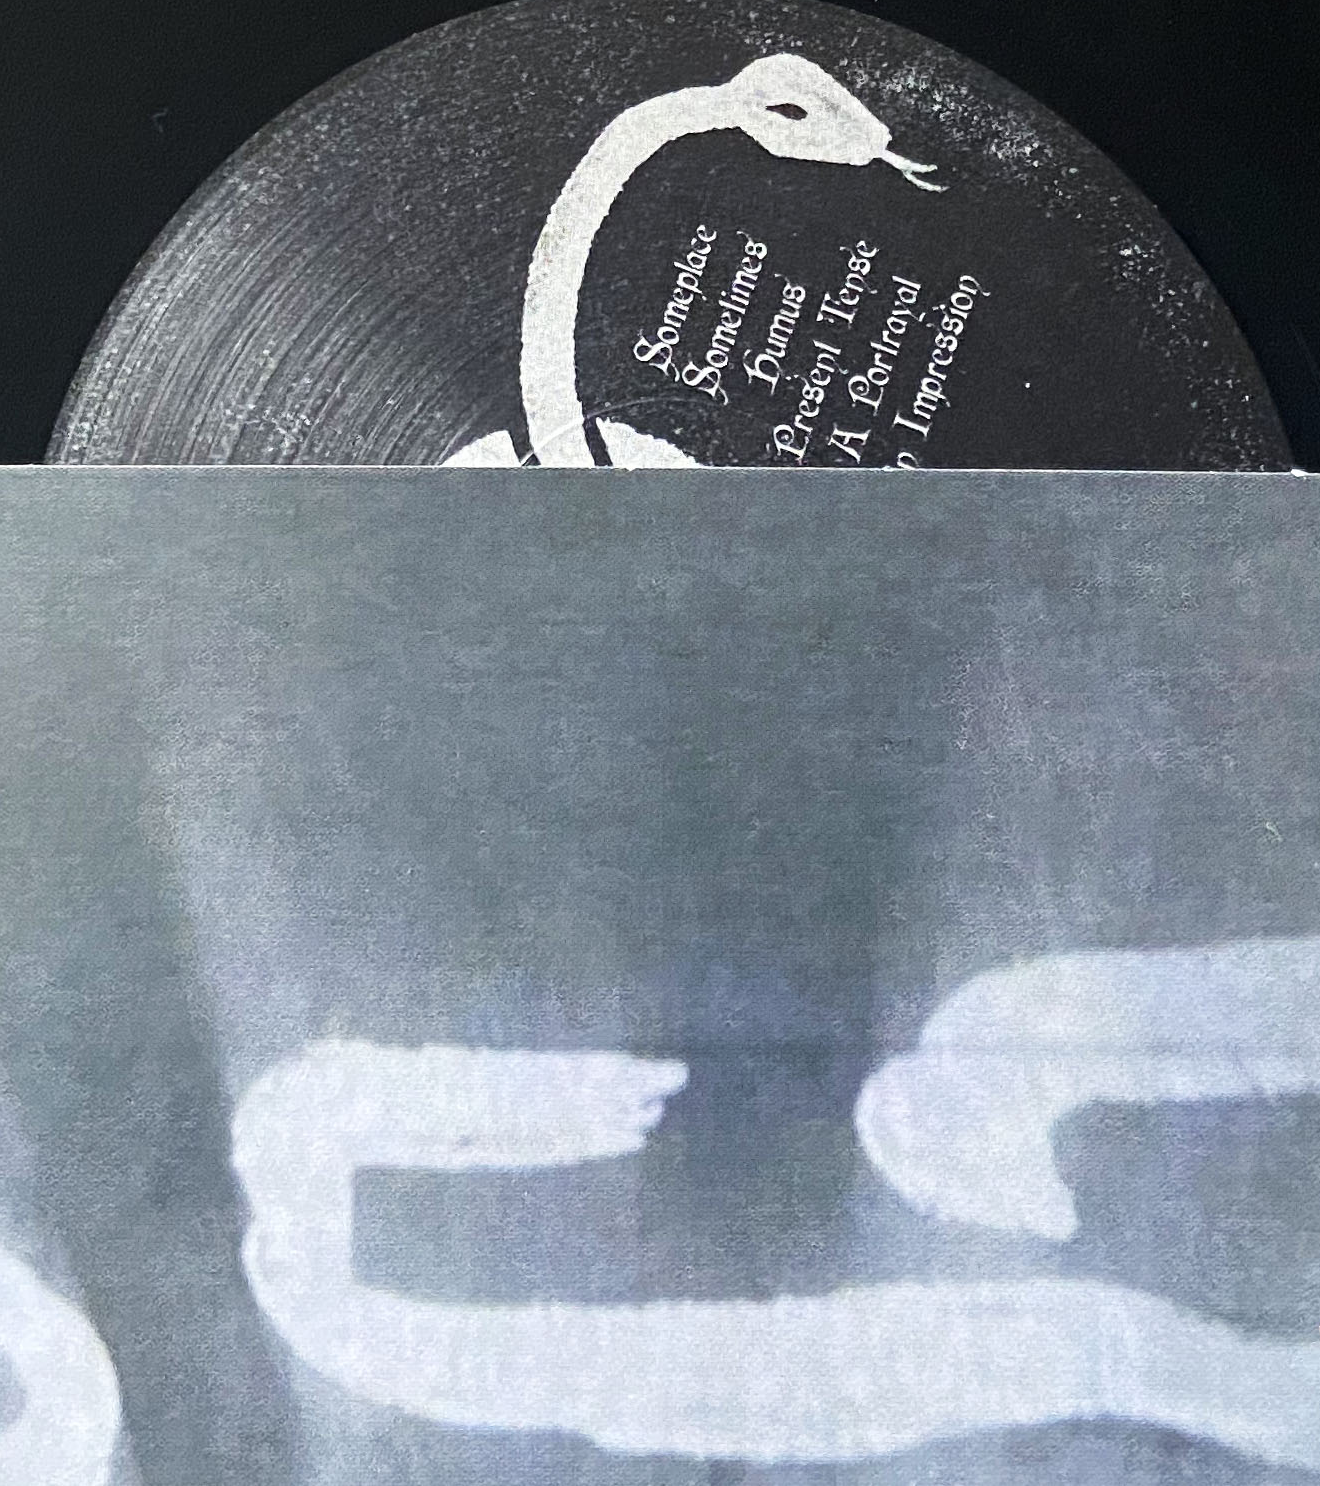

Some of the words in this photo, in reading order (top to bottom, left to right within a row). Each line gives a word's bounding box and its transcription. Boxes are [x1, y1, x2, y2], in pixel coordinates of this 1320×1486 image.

[633, 223, 718, 382] Someplace
[681, 230, 769, 405] Sometimes
[772, 340, 849, 465] Present
[816, 239, 881, 328] Tense
[847, 274, 926, 416] Portrayal
[891, 274, 992, 443] Impression
[827, 422, 872, 464] A
